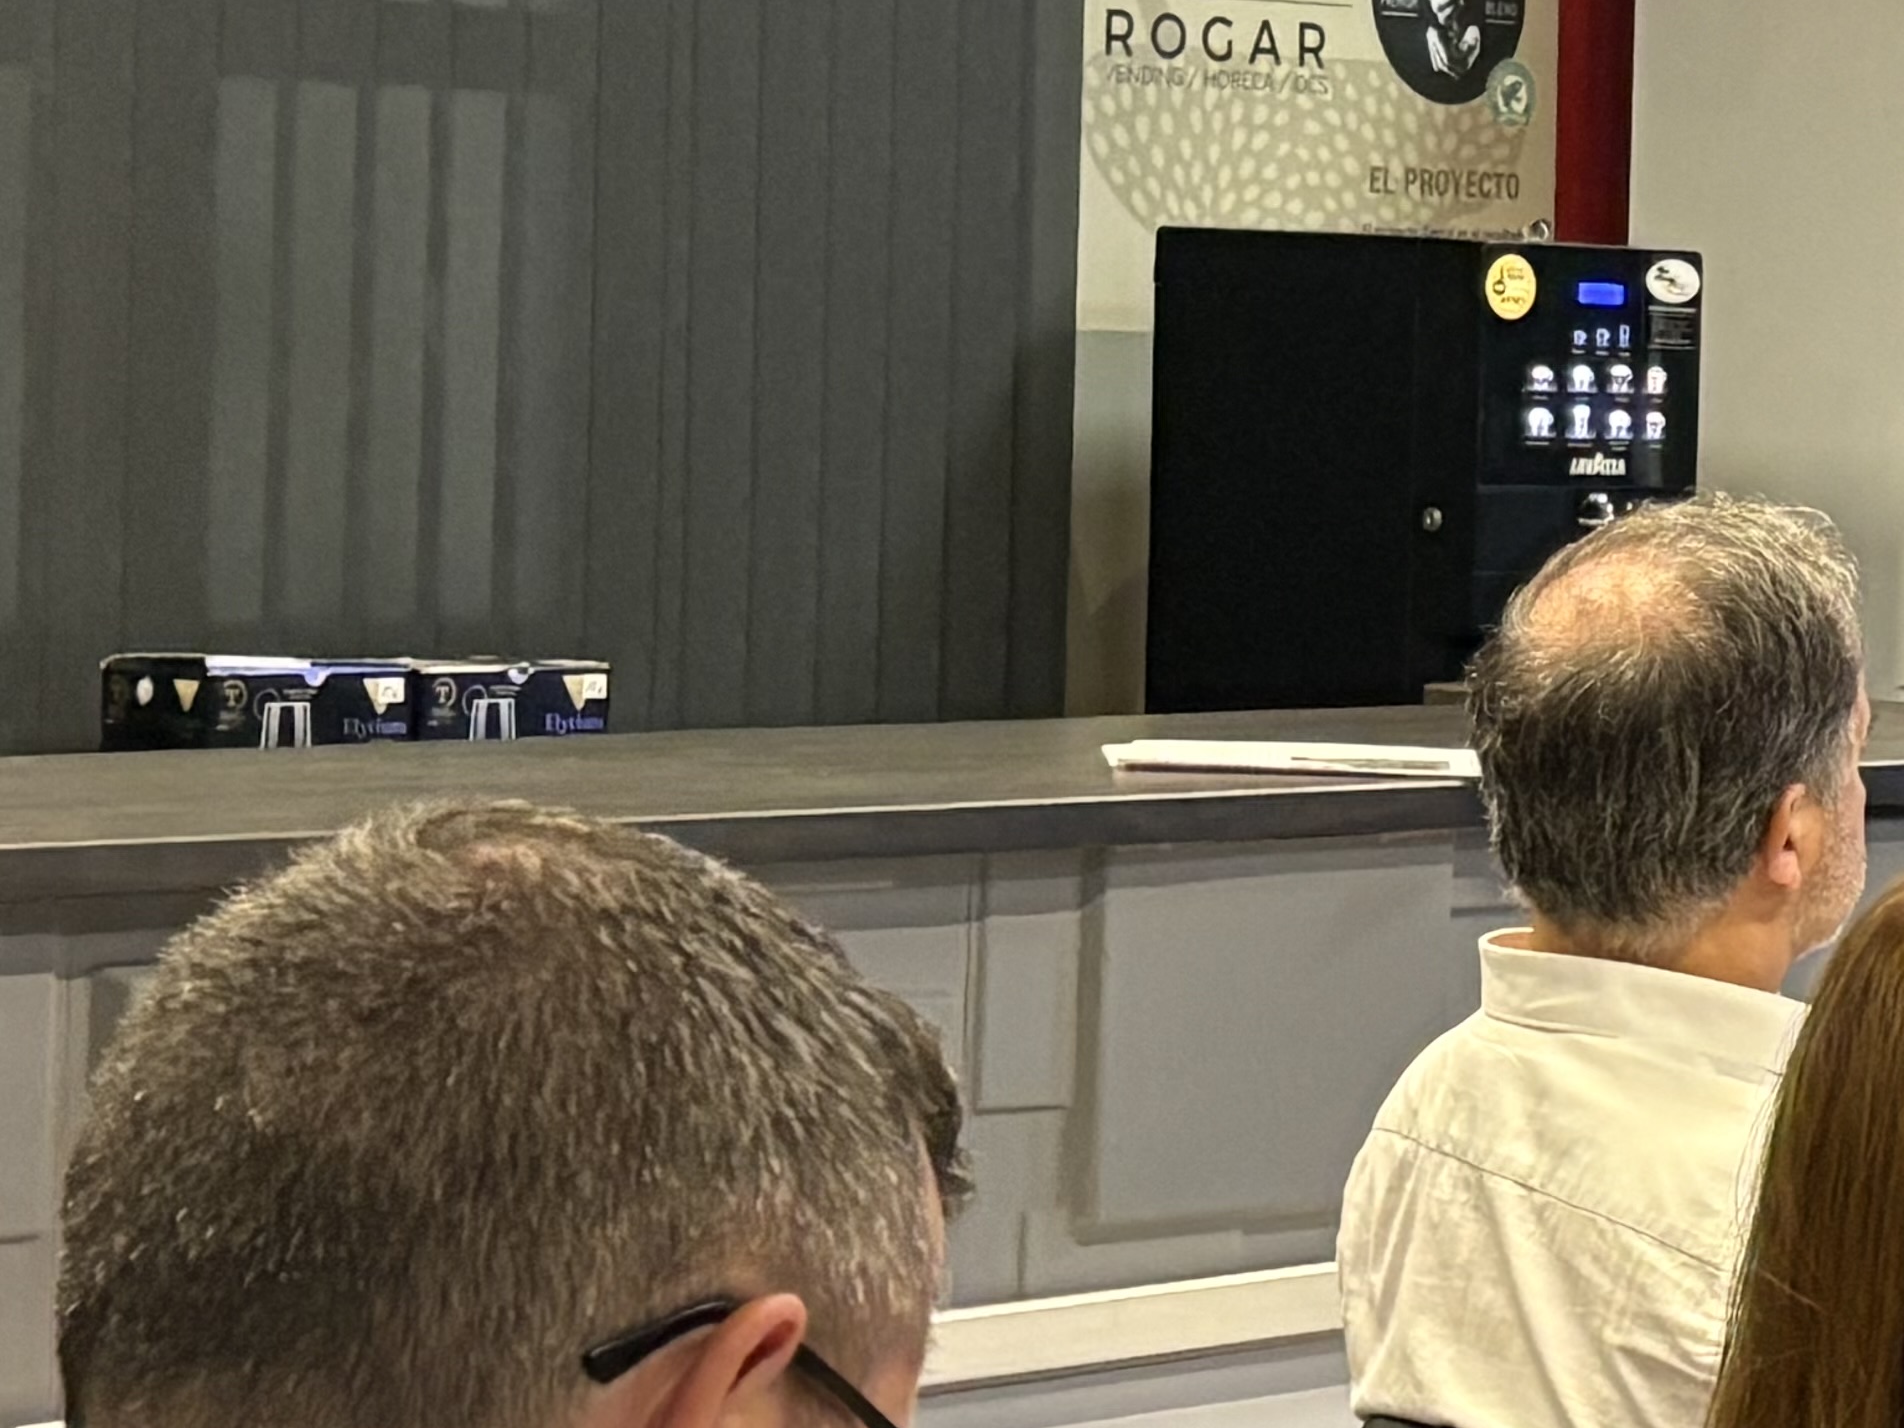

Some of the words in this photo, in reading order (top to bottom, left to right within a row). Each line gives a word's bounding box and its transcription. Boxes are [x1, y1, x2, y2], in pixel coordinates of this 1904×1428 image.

[1104, 8, 1325, 69] ROGAR
[1369, 165, 1396, 196] EL
[1404, 167, 1520, 201] PROYECTO
